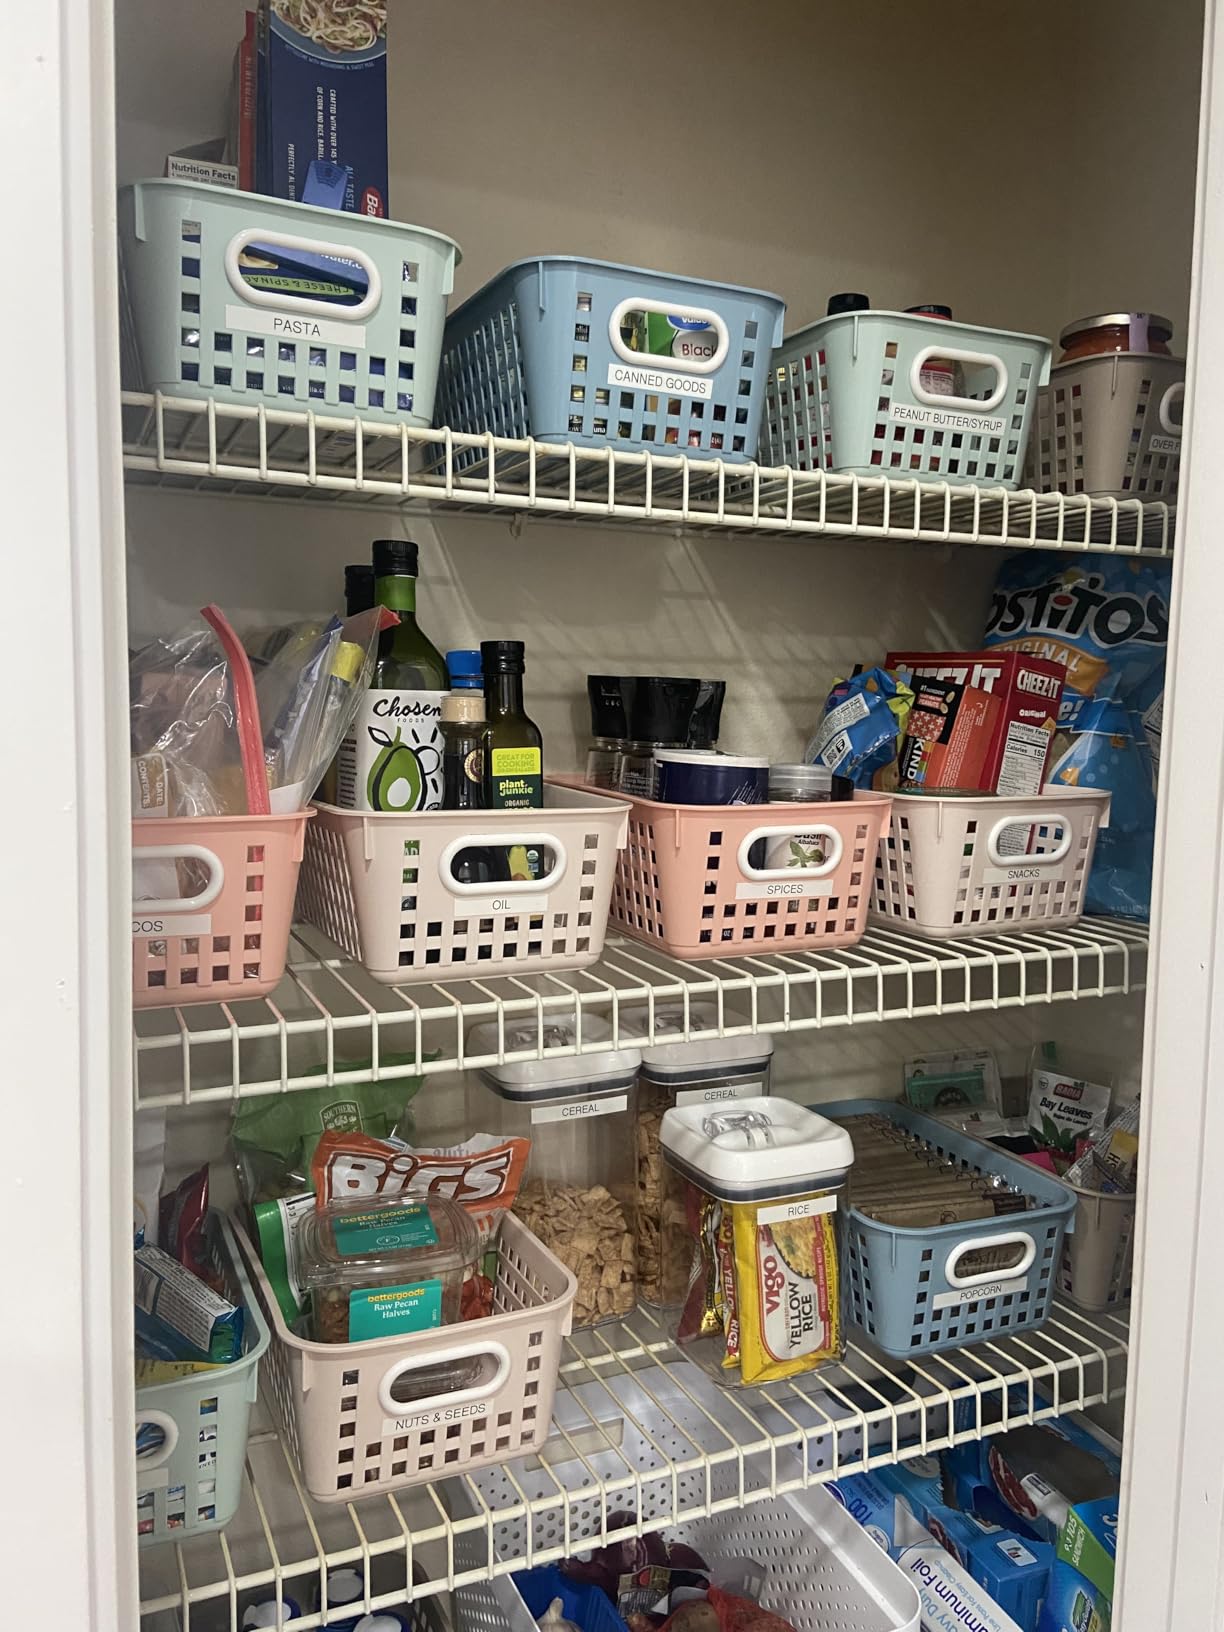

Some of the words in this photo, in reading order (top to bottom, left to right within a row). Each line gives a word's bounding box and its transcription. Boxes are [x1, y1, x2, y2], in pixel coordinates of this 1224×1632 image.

[316, 86, 324, 95] OF
[329, 89, 337, 114] CRAFTED
[329, 115, 337, 131] WITH
[287, 143, 295, 176] PERFECTLY
[171, 162, 210, 177] Nutrition
[212, 169, 236, 181] Facts
[292, 280, 301, 288] &
[304, 282, 350, 294] CHEESE
[273, 317, 321, 337] PASTA
[614, 369, 663, 387] CANNED
[665, 378, 707, 394] GOODS
[893, 407, 931, 422] PEANUT
[933, 413, 1003, 432] BUTTER/SYRUP
[1151, 438, 1173, 450] OVER
[1016, 669, 1061, 699] CHEEZ-IT
[372, 695, 442, 718] Chosen
[1010, 722, 1034, 734] Nutrition
[1035, 728, 1049, 737] Facts
[520, 752, 535, 760] FOR
[906, 737, 926, 780] KIND
[1006, 743, 1028, 753] Calories
[1034, 749, 1045, 758] 150
[496, 760, 535, 768] COOKING
[499, 779, 525, 791] plant
[499, 784, 534, 797] junkie
[504, 799, 530, 807] ORGANIC
[1007, 868, 1041, 880] SNACKS
[766, 883, 804, 895] SPICES
[492, 899, 511, 911] OIL
[703, 1088, 738, 1101] CEREAL
[561, 1103, 600, 1117] CEREAL
[1039, 1096, 1057, 1112] Bay
[1057, 1101, 1094, 1120] Leaves
[340, 1207, 421, 1224] bettergoods
[787, 1204, 810, 1217] RICE
[367, 1287, 425, 1303] bettergoods
[723, 1268, 735, 1309] YELLO
[959, 1284, 1002, 1301] POPCORN
[374, 1302, 393, 1312] Raw
[394, 1298, 419, 1309] Pecan
[382, 1307, 411, 1319] Halves
[788, 1282, 803, 1350] YELLOW
[801, 1294, 814, 1333] RICE
[727, 1319, 739, 1349] RICE
[395, 1414, 429, 1431] NUTS
[433, 1412, 441, 1423] &
[444, 1403, 486, 1420] SEEDS
[910, 1557, 938, 1587] Foil
